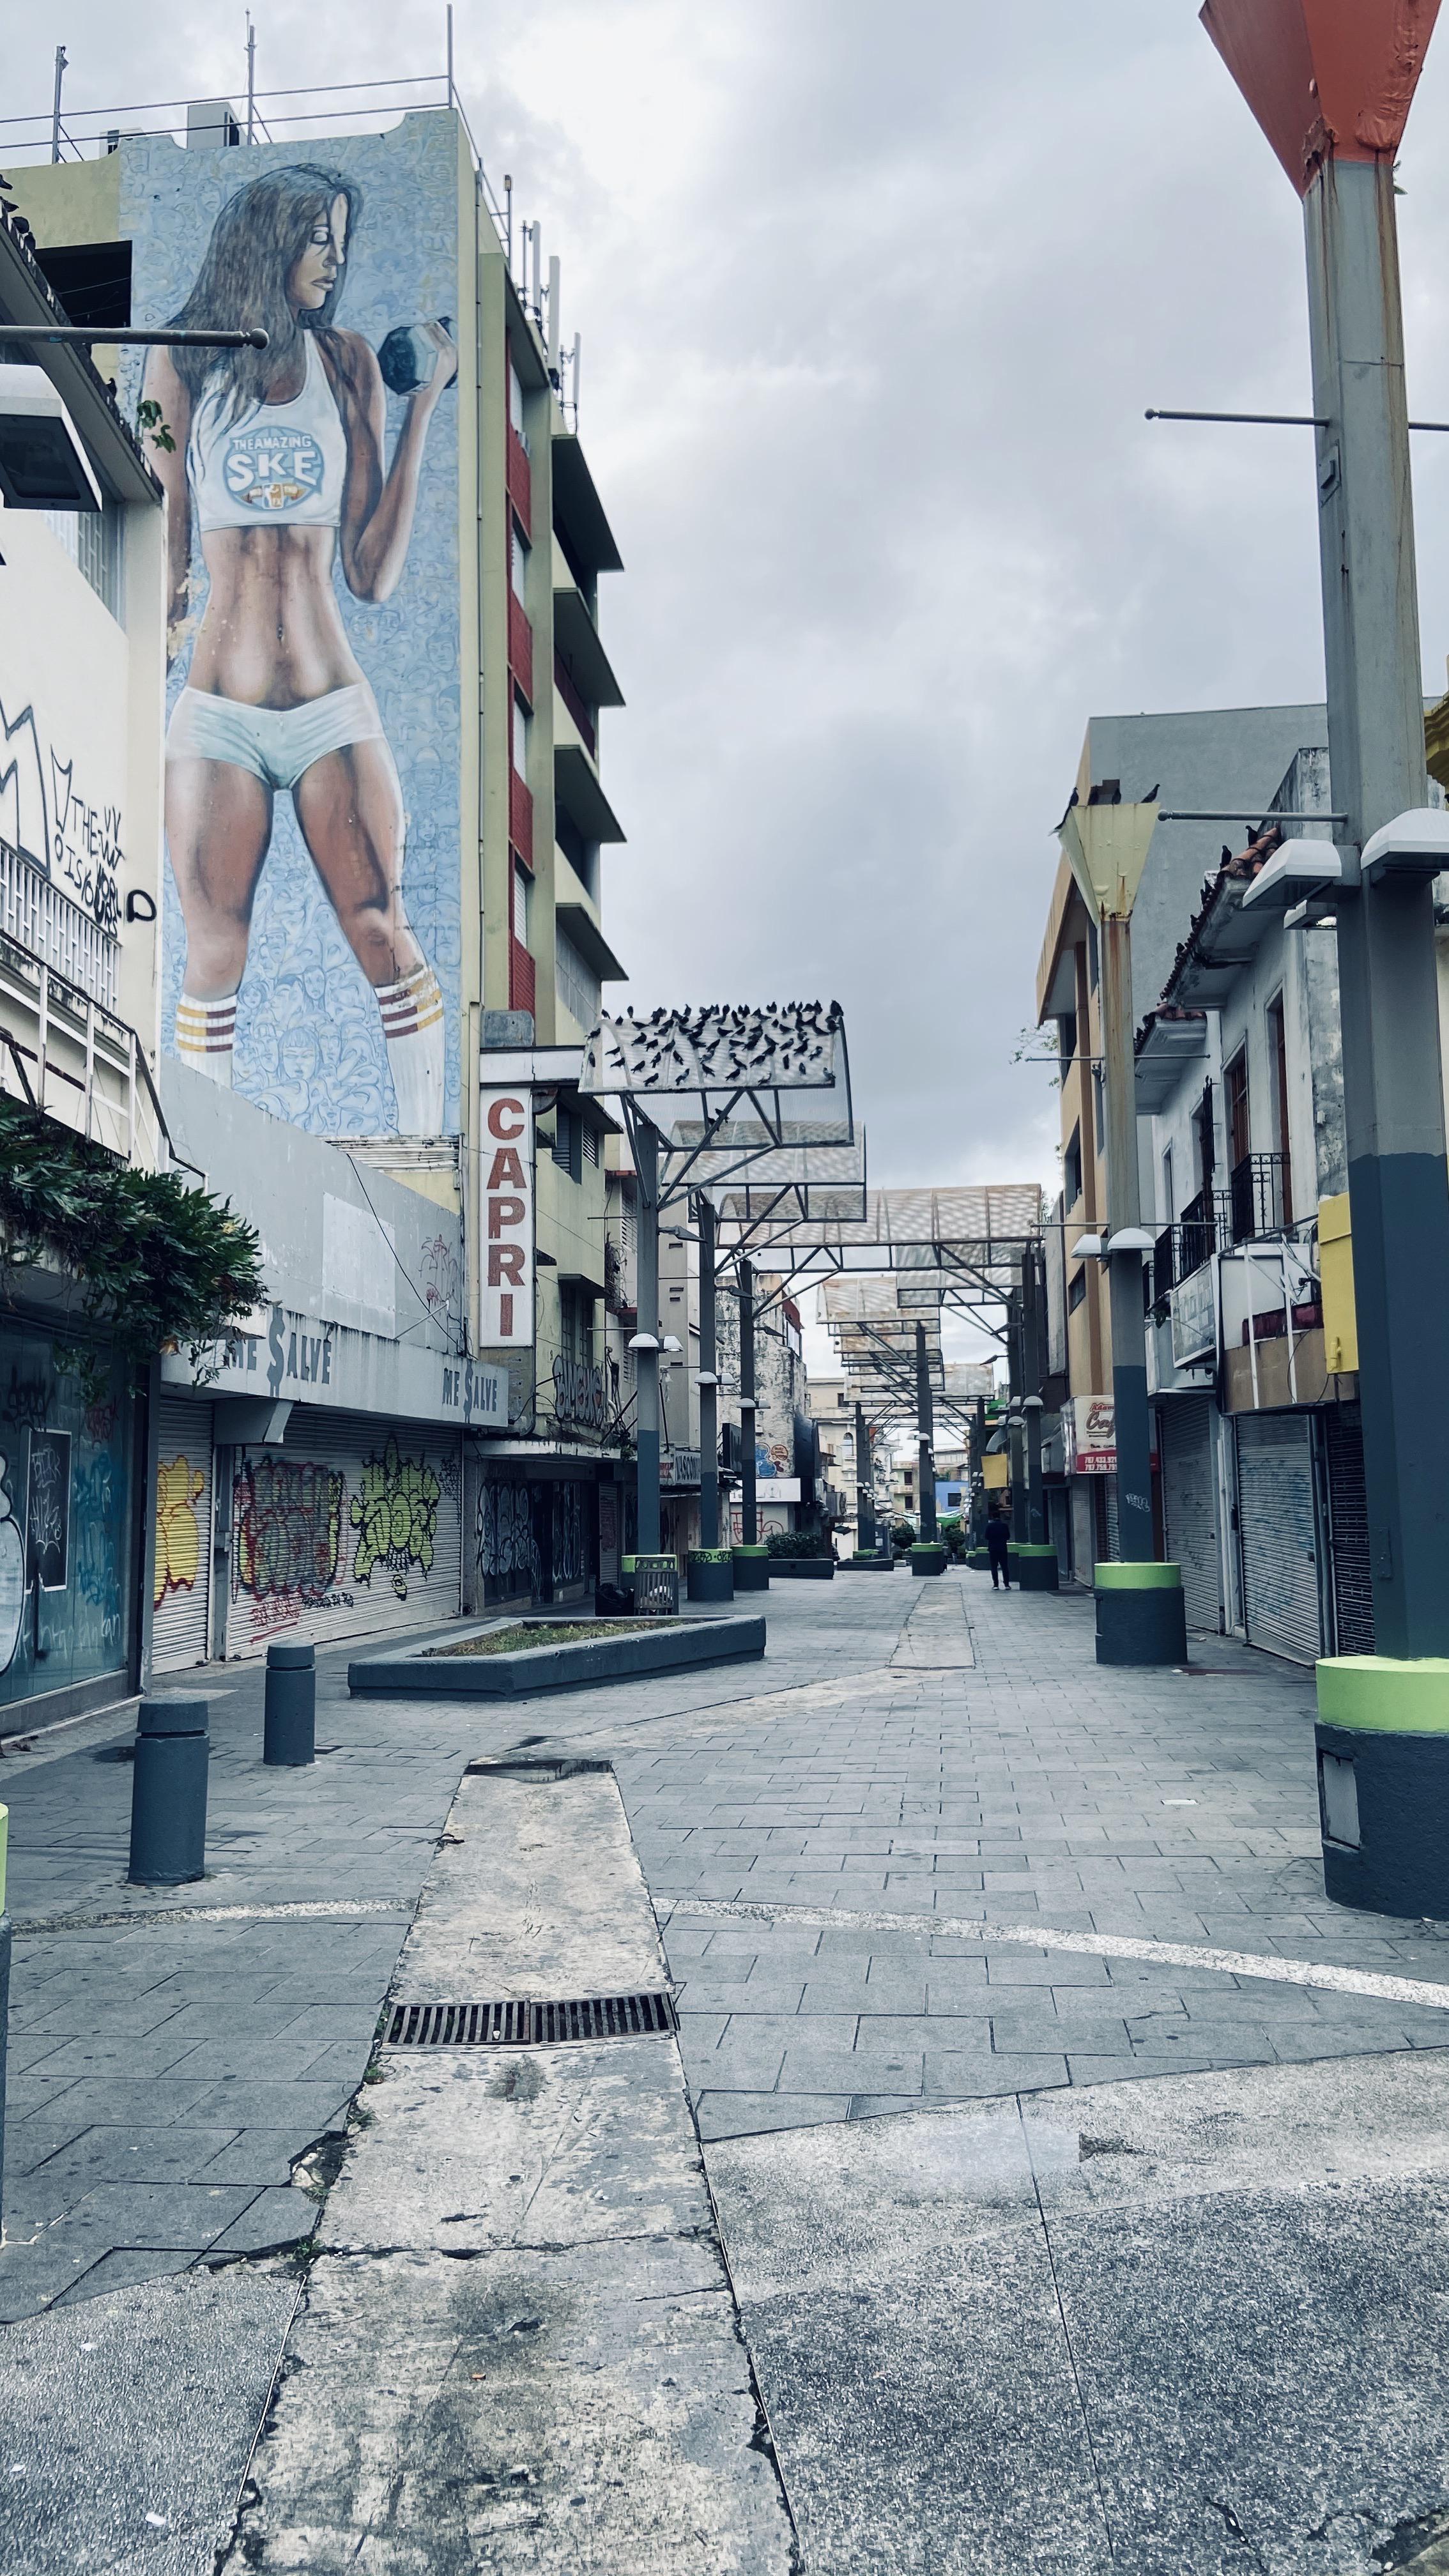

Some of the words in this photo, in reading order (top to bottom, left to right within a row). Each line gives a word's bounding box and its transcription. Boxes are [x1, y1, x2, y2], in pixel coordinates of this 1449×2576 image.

[227, 450, 318, 492] SKE
[233, 438, 254, 450] THE
[256, 435, 312, 450] AMAZING
[486, 1098, 527, 1337] CAPRI
[266, 1305, 332, 1398] SALVE
[442, 1367, 460, 1406] ME
[463, 1359, 498, 1424] SALVE
